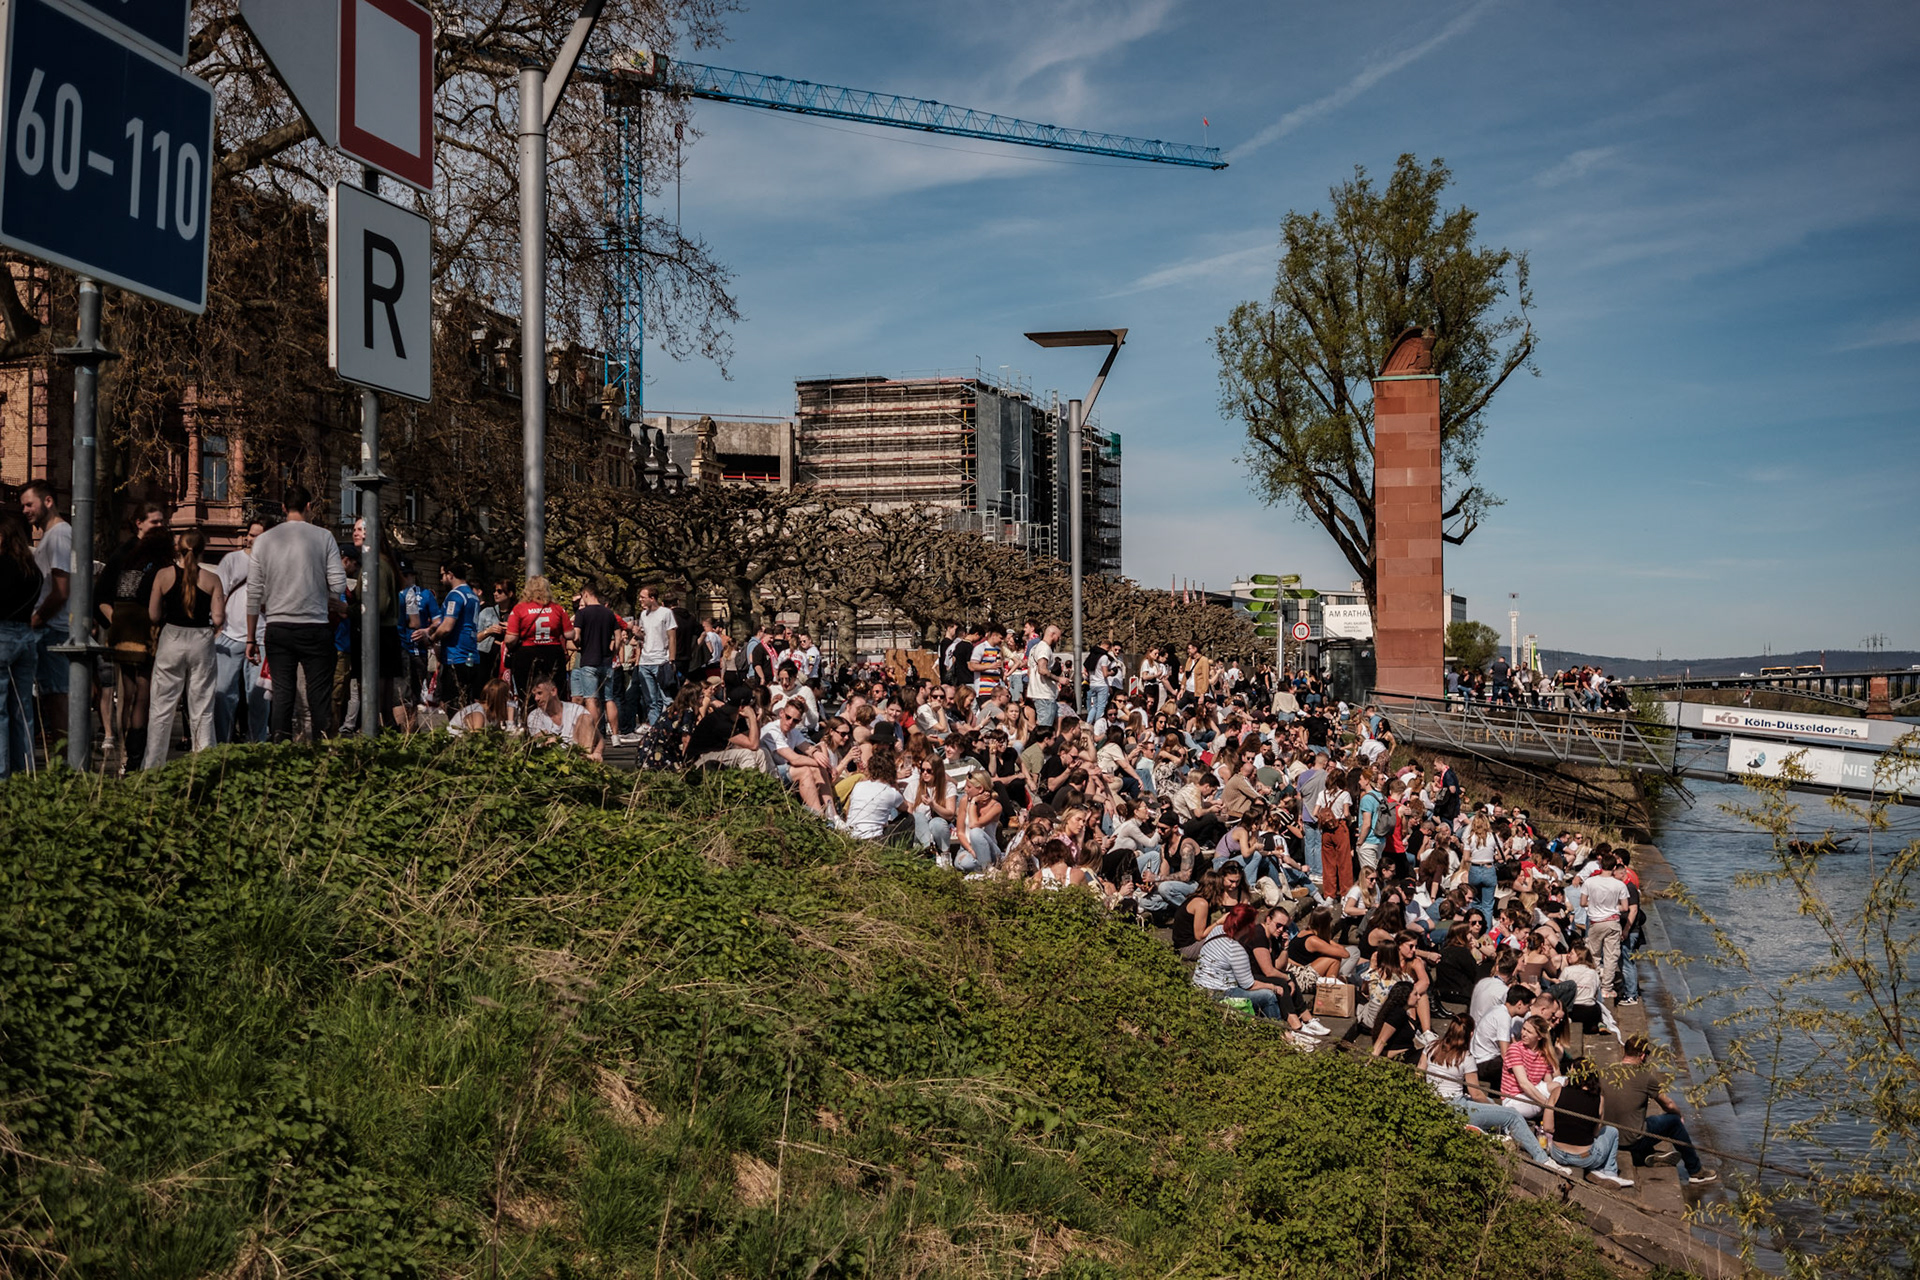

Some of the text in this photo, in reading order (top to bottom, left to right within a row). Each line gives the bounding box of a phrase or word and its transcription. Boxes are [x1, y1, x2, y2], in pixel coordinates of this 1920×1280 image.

[15, 68, 202, 242] 60-110
[363, 229, 407, 360] R
[1329, 610, 1342, 618] AM
[535, 616, 550, 640] 6
[1298, 627, 1305, 635] 10
